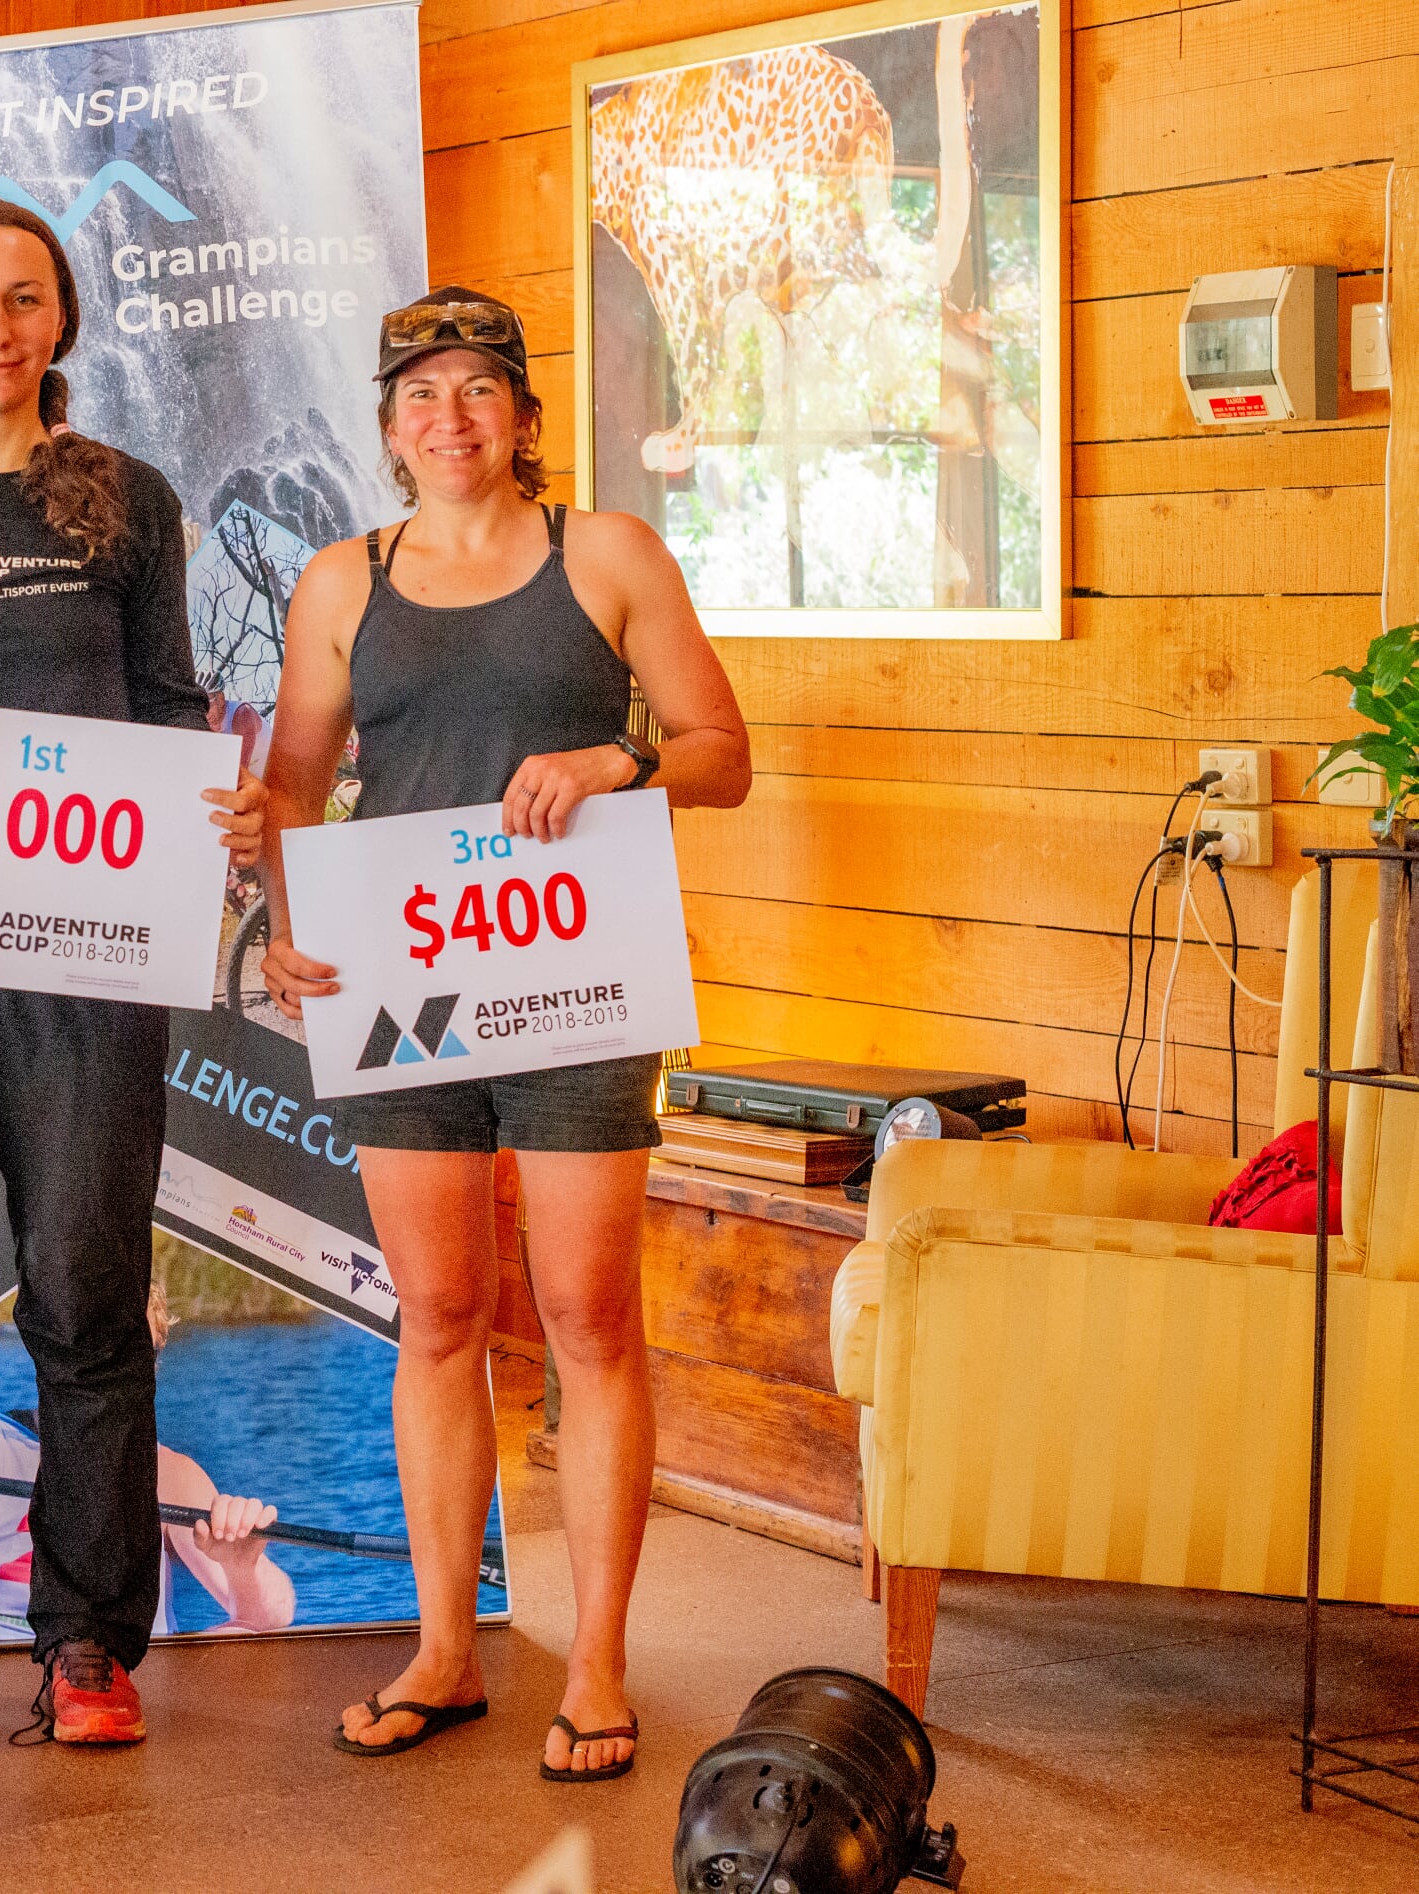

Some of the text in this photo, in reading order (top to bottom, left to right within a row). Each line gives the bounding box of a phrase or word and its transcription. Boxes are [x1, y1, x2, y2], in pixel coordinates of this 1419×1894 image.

[36, 71, 269, 133] INSPIRED
[111, 225, 377, 282] Grampians
[115, 284, 360, 335] Challenge
[50, 581, 89, 593] EVENTS
[20, 734, 68, 774] 1st
[403, 871, 587, 969] $400
[51, 939, 149, 966] 2018-2019
[474, 982, 625, 1021] ADVENTURE
[476, 1004, 628, 1040] CUP 2018-2019
[163, 1048, 360, 1175] LENGE.CO
[225, 1223, 250, 1241] Council
[228, 1216, 306, 1263] Horsham Rural City
[321, 1251, 399, 1299] VISIT VICTORIA
